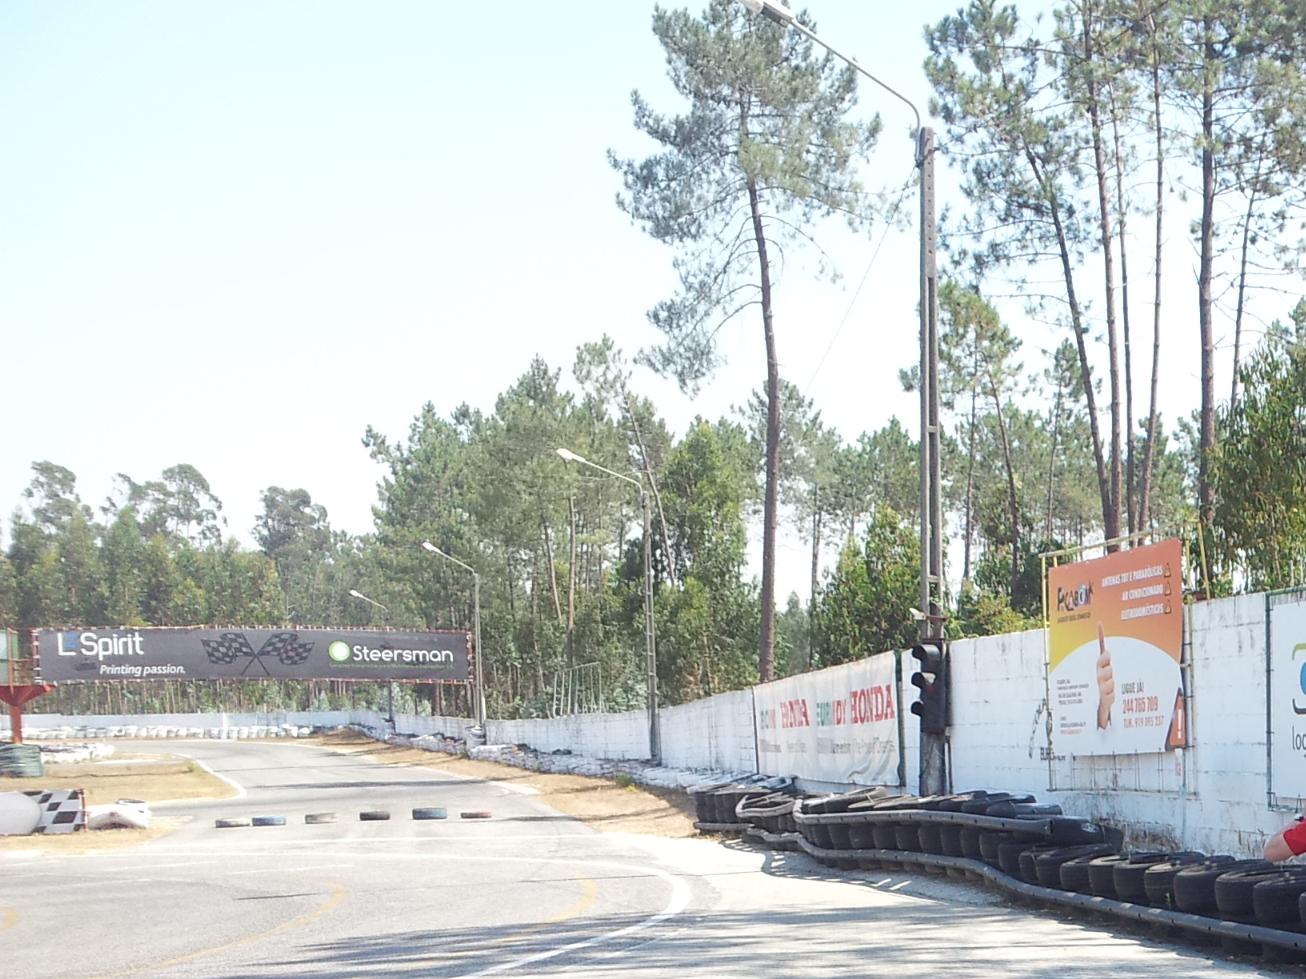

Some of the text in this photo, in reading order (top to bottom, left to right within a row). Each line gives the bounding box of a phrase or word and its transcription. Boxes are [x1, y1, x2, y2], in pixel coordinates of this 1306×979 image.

[352, 645, 454, 662] Steersman
[100, 663, 186, 677] Printing passion.
[850, 684, 896, 724] HONDA
